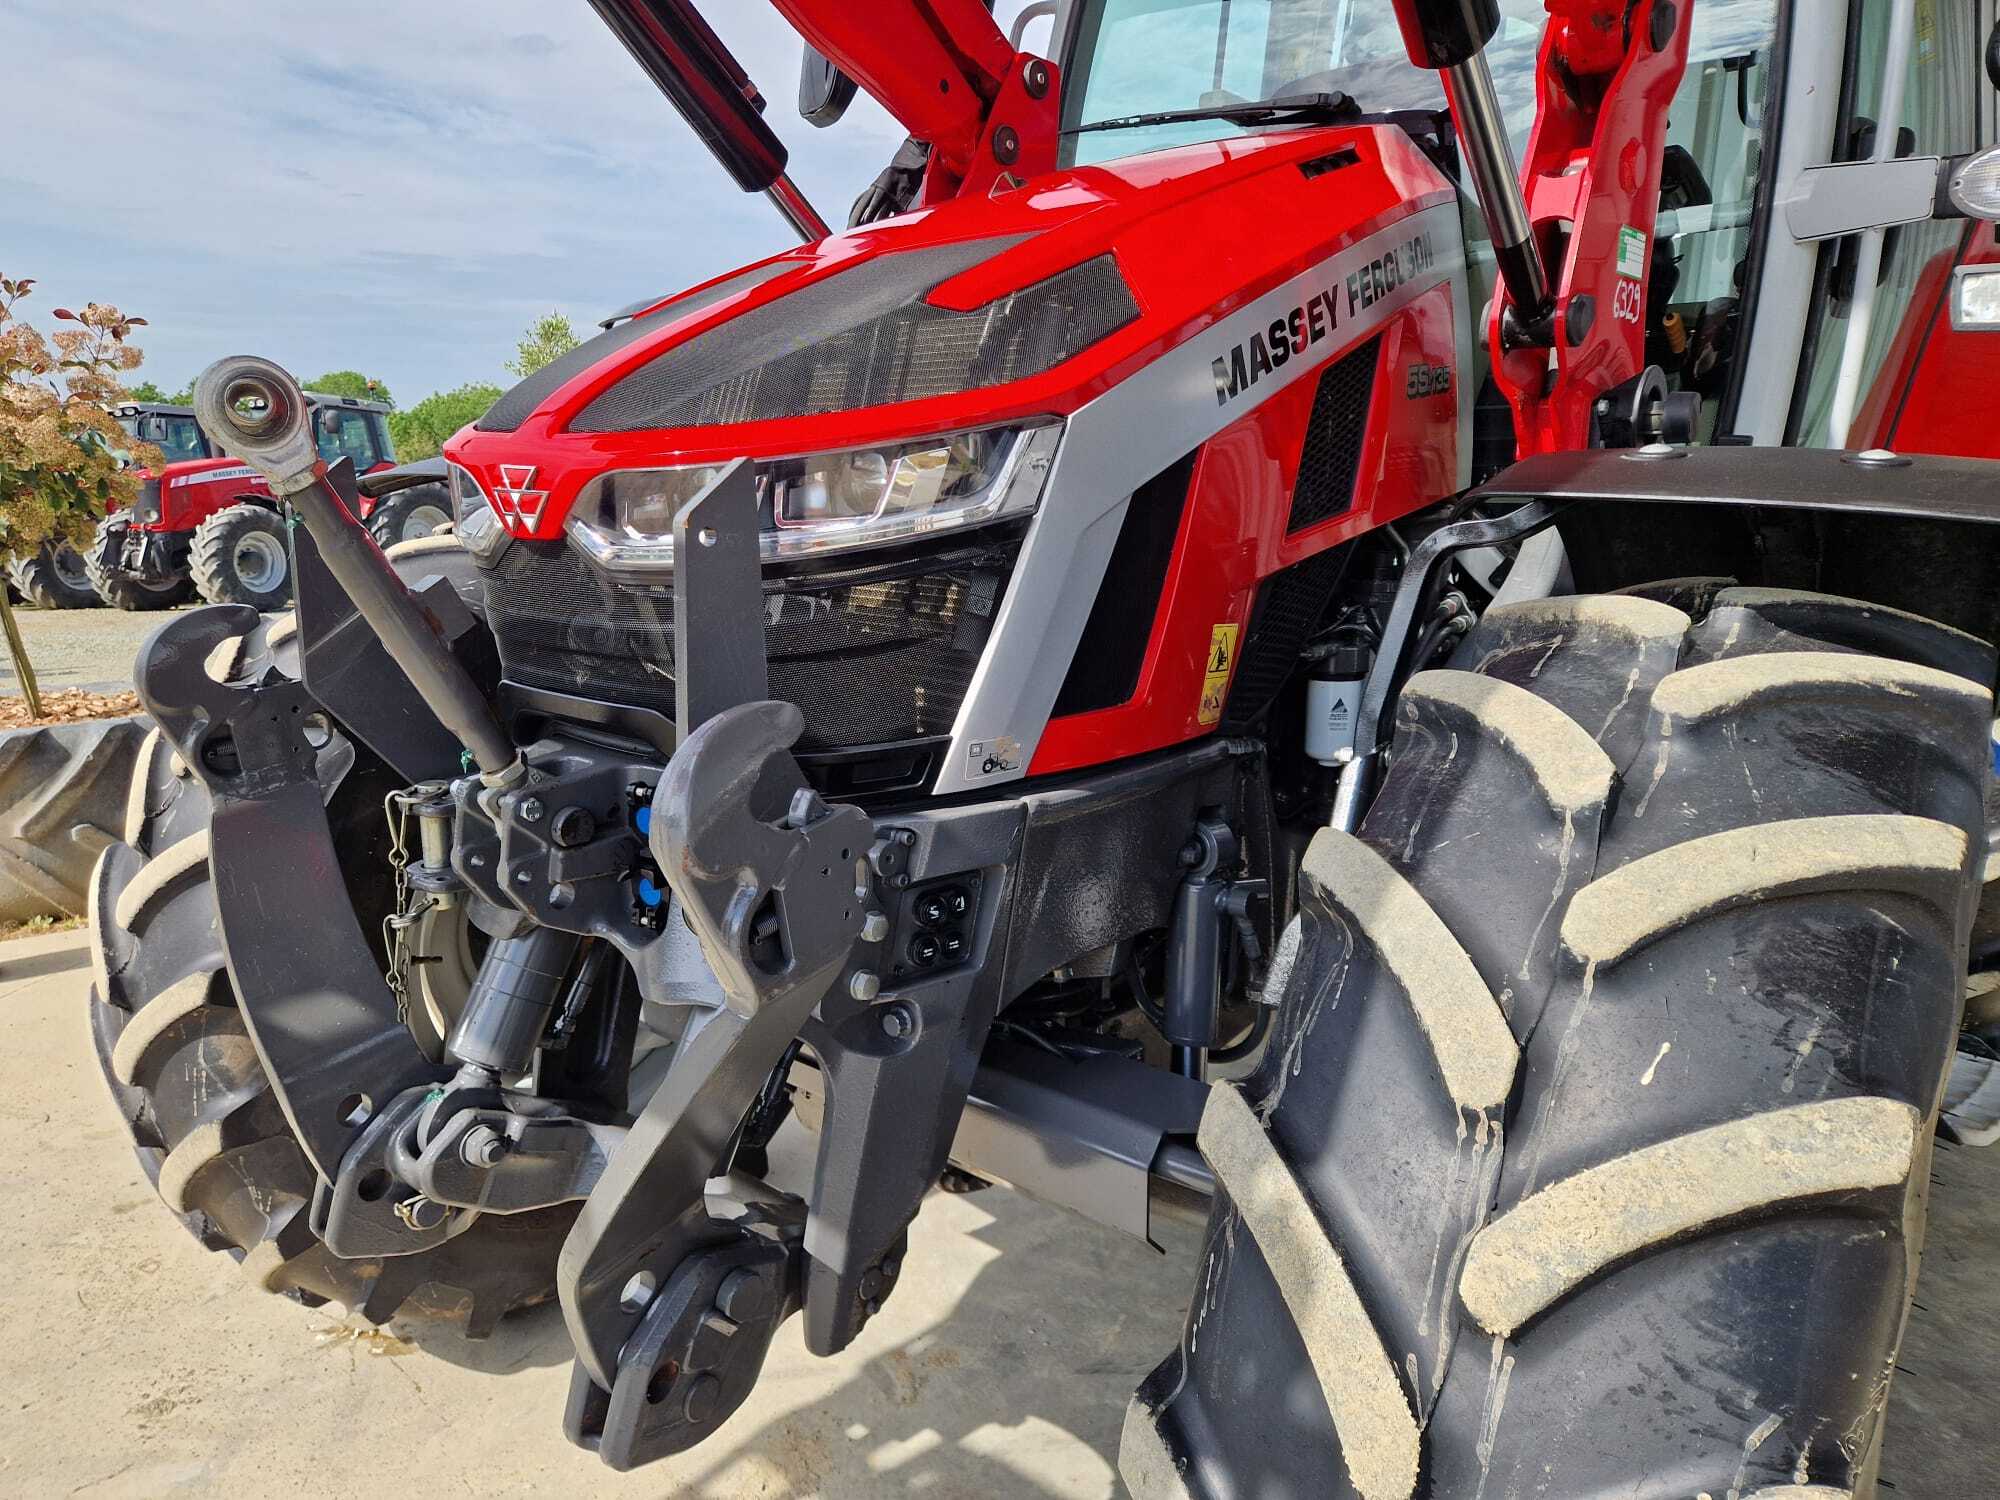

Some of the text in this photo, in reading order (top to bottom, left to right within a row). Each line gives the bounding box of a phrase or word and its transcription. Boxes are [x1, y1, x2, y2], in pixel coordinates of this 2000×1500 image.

[1211, 231, 1434, 408] MASSEY FERGUSON
[1613, 279, 1641, 324] 6329
